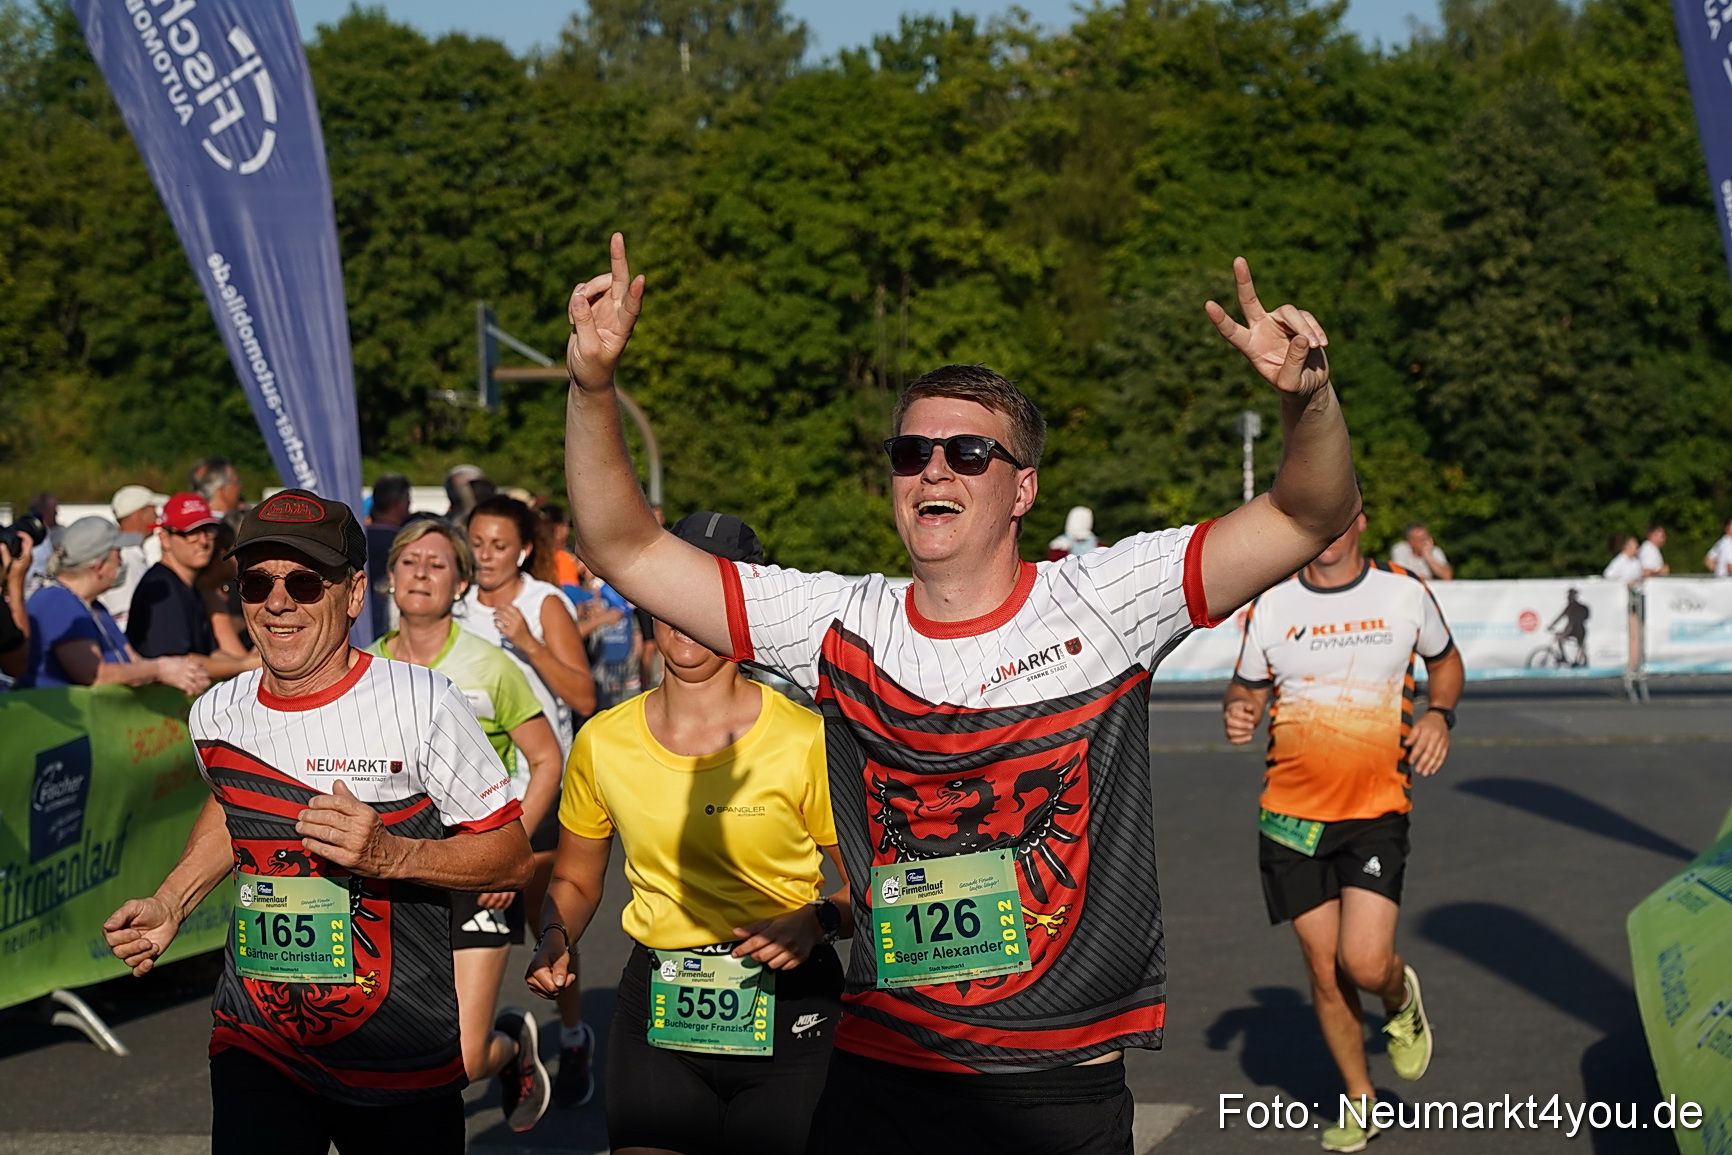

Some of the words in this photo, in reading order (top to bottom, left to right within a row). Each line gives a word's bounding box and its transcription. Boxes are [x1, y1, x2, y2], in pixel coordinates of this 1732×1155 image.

[1310, 632, 1393, 651] DYNAMICS
[1027, 671, 1049, 683] STARKE
[1050, 664, 1069, 675] STADT
[306, 759, 385, 773] NEUMARKT
[901, 880, 943, 896] Firmenlauf
[918, 889, 944, 899] neumarkt
[253, 895, 288, 903] Firmenlauf
[255, 912, 316, 948] 165
[905, 899, 981, 944] 126
[998, 899, 1020, 956] 2022
[238, 920, 247, 956] RUN
[331, 920, 346, 968] 2022
[880, 922, 896, 964] RUN
[246, 948, 279, 961] Gärtner
[280, 951, 333, 962] Christian
[895, 950, 929, 965] Seger
[932, 941, 1004, 959] Alexander
[654, 994, 666, 1028] RUN
[677, 986, 739, 1021] 559
[664, 1019, 710, 1032] Buchberger
[711, 1024, 754, 1033] Franziska
[797, 1013, 819, 1025] NIKE
[796, 1030, 822, 1039] AIR
